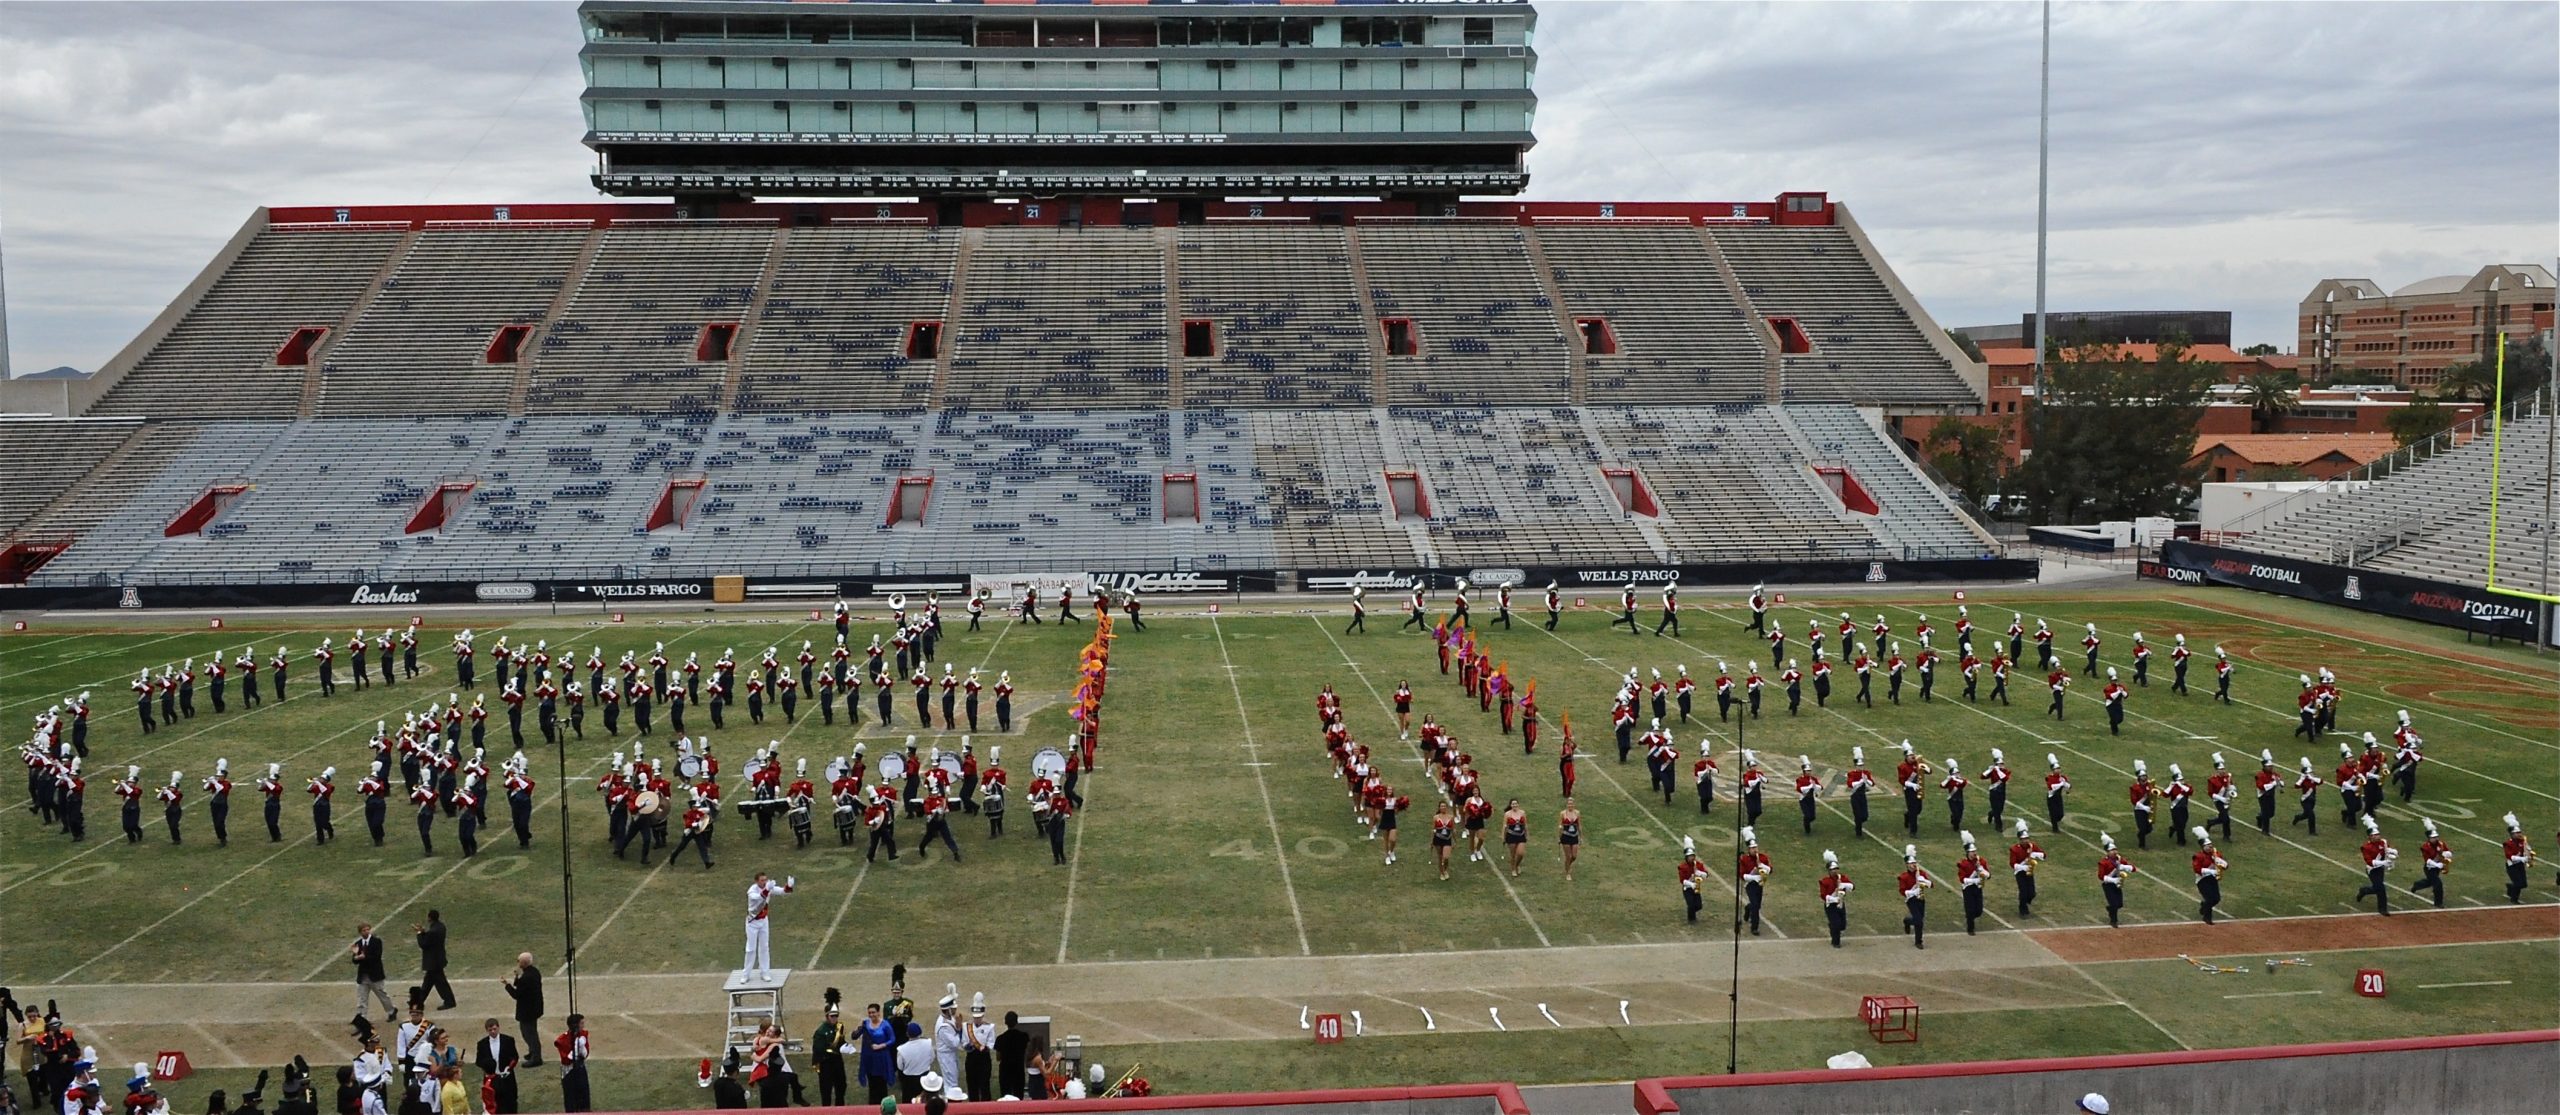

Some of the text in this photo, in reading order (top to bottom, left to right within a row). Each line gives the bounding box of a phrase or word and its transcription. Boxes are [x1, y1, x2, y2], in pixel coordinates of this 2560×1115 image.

[336, 214, 348, 222] 17
[676, 210, 688, 219] 19
[877, 209, 890, 218] 20
[1028, 209, 1038, 217] 21
[1249, 209, 1262, 218] 22
[1444, 208, 1457, 217] 23
[1578, 570, 1680, 582] WELLS FARGO
[592, 584, 701, 596] WELLS FARGO
[1052, 580, 1070, 590] BAD
[1072, 579, 1084, 589] DAY
[351, 584, 420, 604] Bashas'
[1604, 824, 1741, 849] 30
[1210, 836, 1350, 860] 40
[2363, 974, 2384, 993] 20
[1318, 1018, 1338, 1038] 40
[156, 1056, 176, 1076] 40
